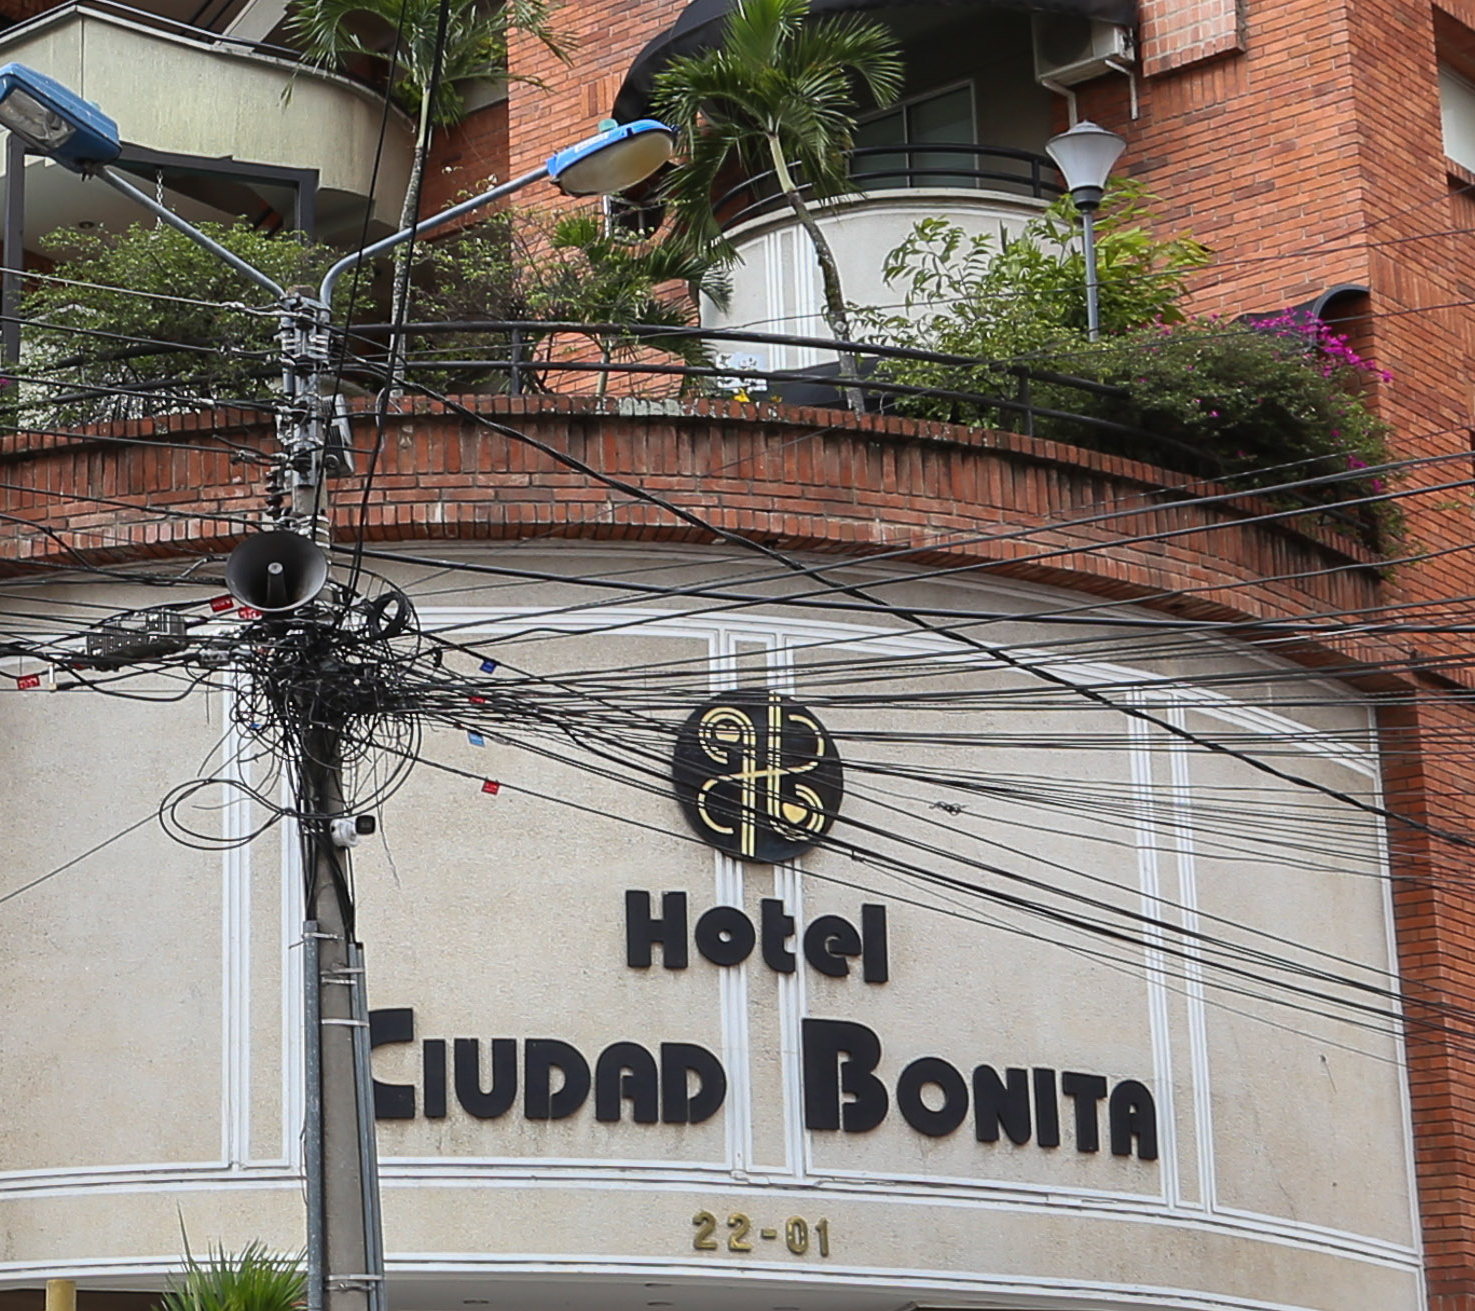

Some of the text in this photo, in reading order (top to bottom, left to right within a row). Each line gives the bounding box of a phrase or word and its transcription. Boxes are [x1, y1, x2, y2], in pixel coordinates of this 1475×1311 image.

[626, 890, 888, 984] Hotel
[370, 1007, 1159, 1161] CIUDAD BONITA
[692, 1211, 831, 1258] 22-01
